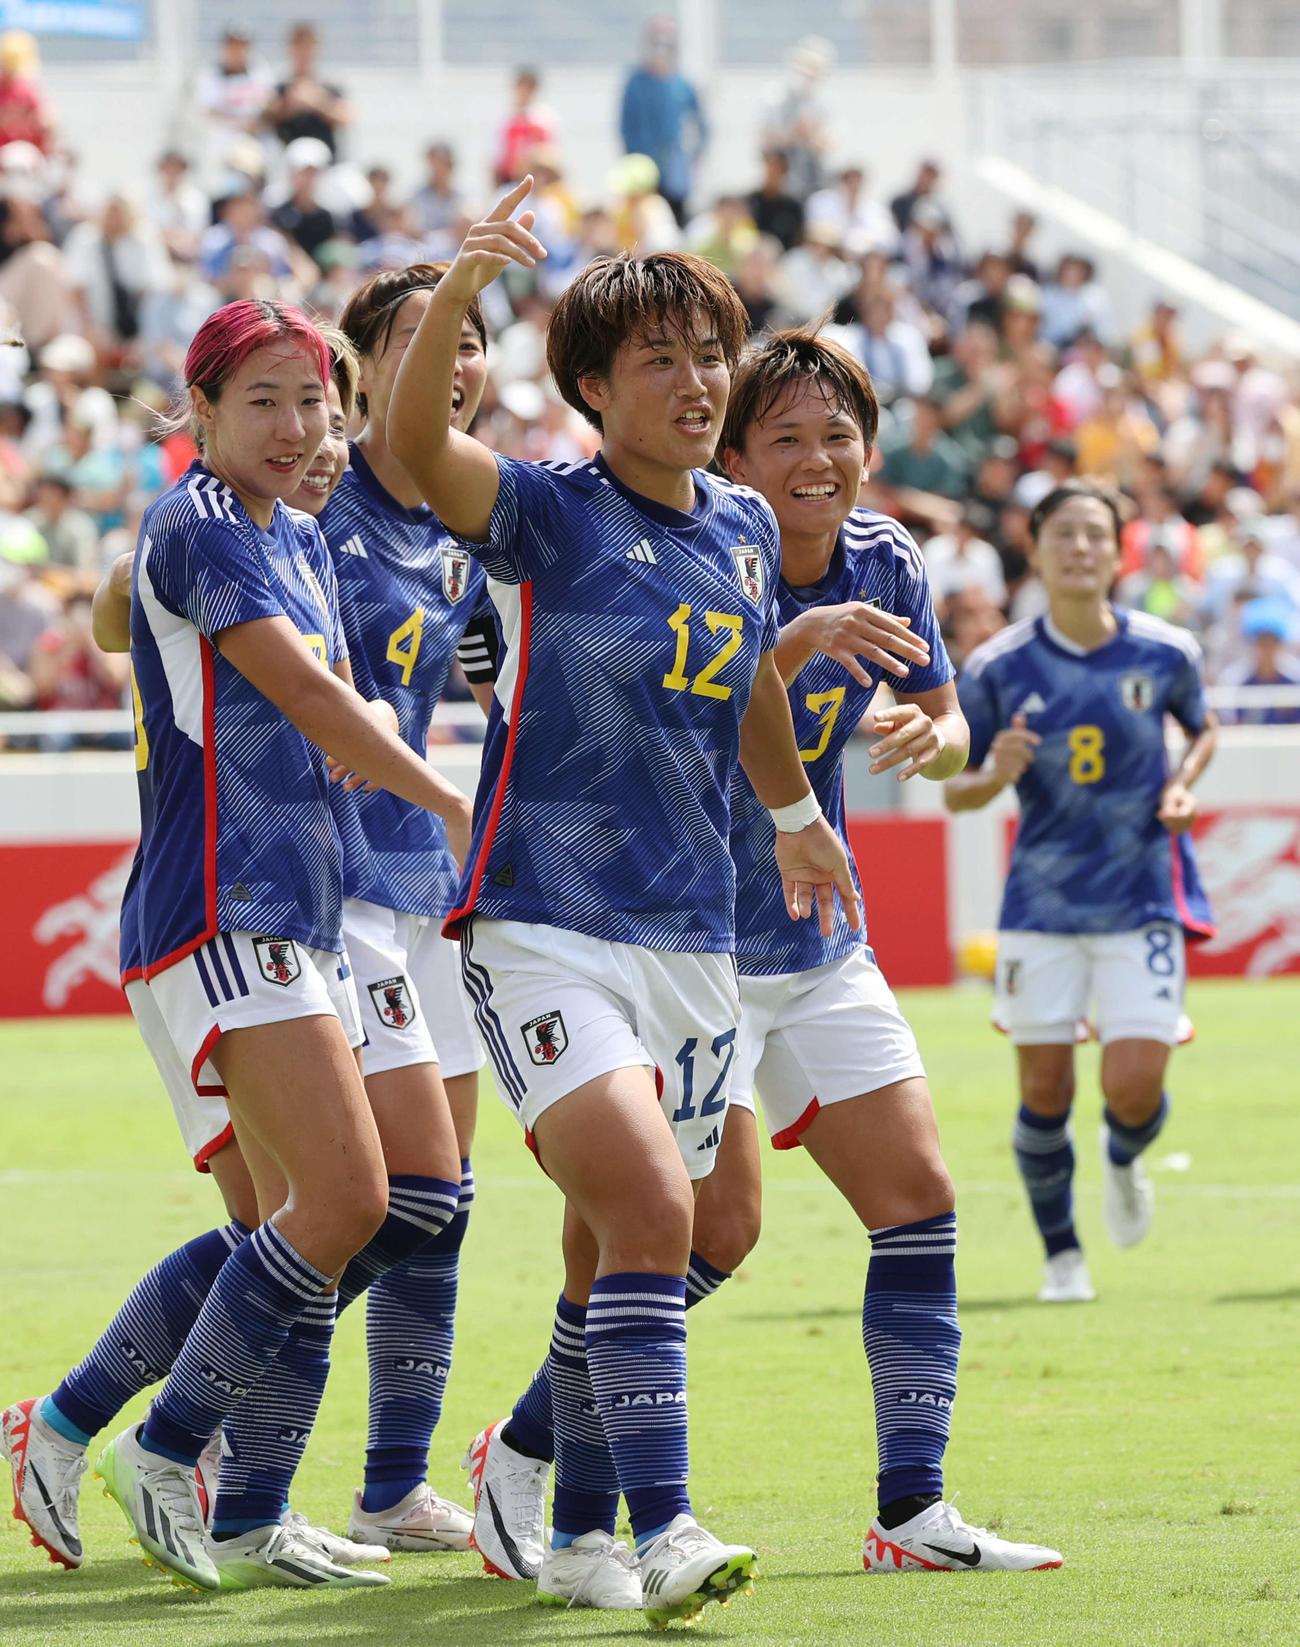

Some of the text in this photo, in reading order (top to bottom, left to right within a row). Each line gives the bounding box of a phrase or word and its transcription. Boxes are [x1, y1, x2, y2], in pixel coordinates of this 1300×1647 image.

[385, 607, 423, 687] 4
[662, 603, 743, 700] 12
[1069, 725, 1105, 785] 8
[1146, 929, 1174, 977] 8
[377, 979, 397, 988] JAPAN
[529, 1015, 551, 1027] JAPAN
[673, 1028, 736, 1122] 12
